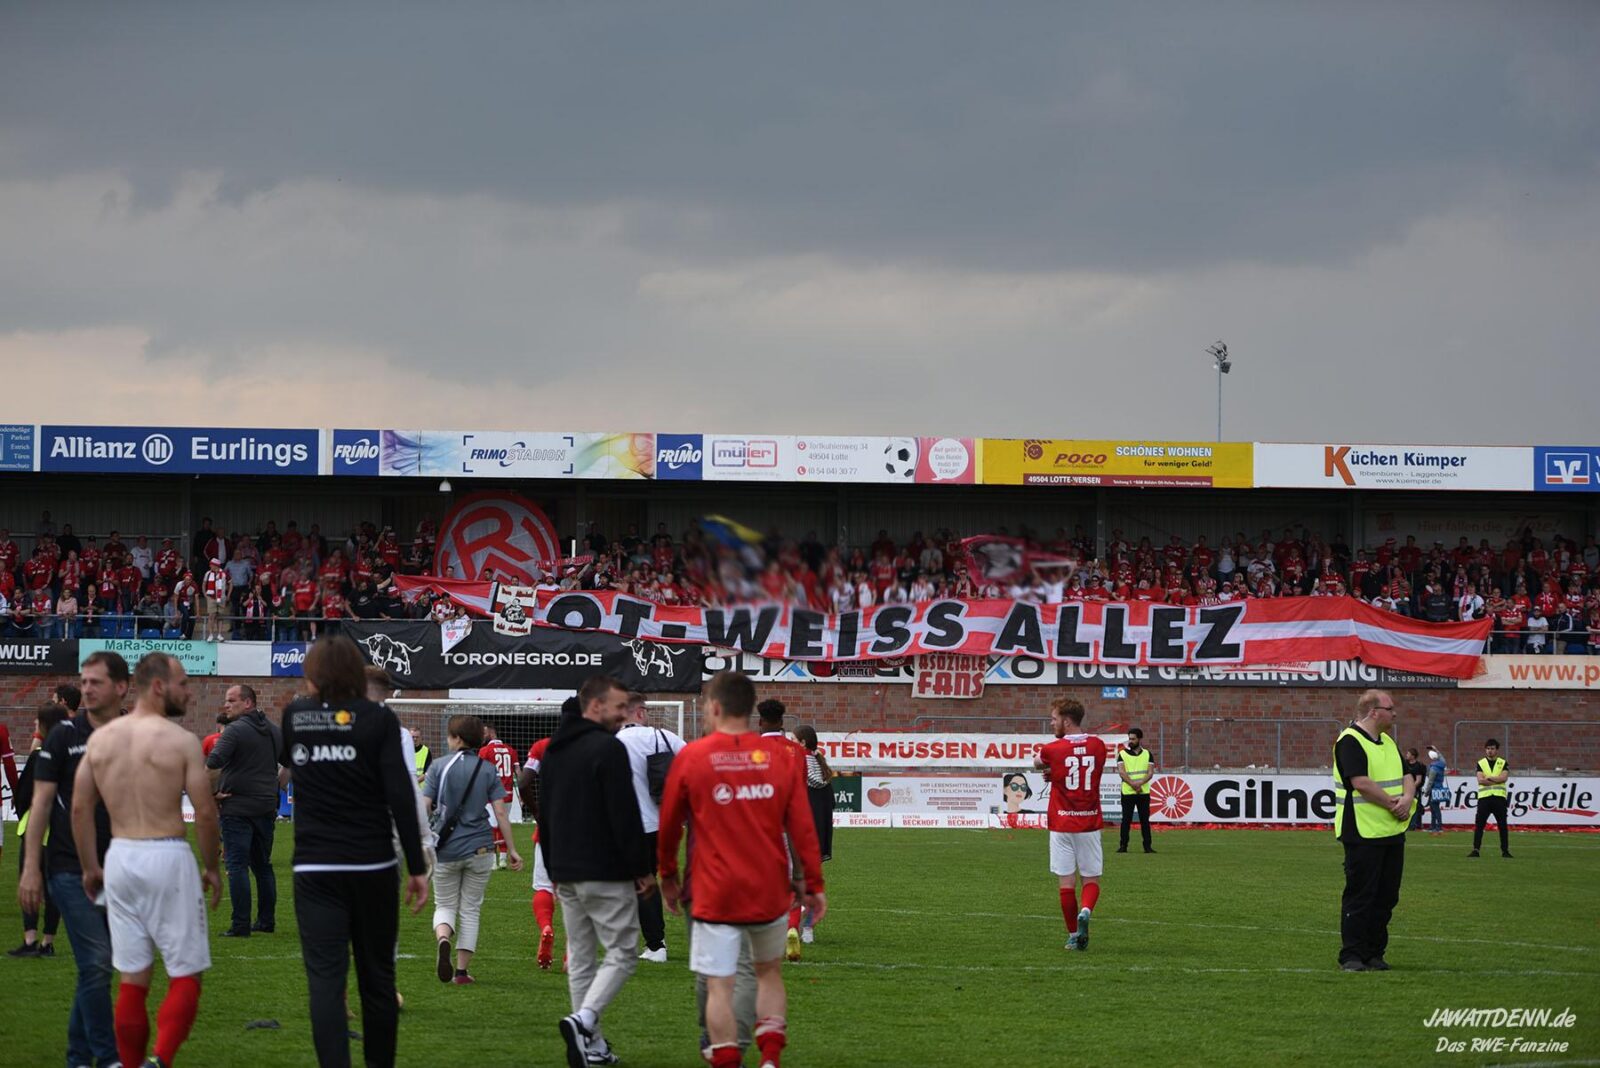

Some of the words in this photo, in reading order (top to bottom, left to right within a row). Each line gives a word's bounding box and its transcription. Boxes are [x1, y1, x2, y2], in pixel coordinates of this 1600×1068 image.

[50, 436, 136, 459] Allianz
[191, 437, 309, 467] Eurlings
[334, 444, 380, 460] FRIMO
[657, 448, 702, 464] FRIMO
[717, 446, 772, 459] müller
[809, 453, 829, 461] 49504
[1116, 444, 1165, 457] SCHÖNES
[1168, 447, 1212, 457] WOHNEN
[1054, 453, 1107, 465] POCO
[1158, 461, 1188, 469] weniger
[1325, 446, 1398, 485] Küchen
[1404, 452, 1467, 469] Kümper
[1028, 475, 1049, 483] 49504
[1050, 475, 1101, 484] LOTTE-WERSEN
[1411, 470, 1458, 478] Laggenbeck
[1418, 519, 1441, 533] Hier
[1445, 518, 1480, 533] fallen
[1482, 518, 1503, 533] die
[489, 582, 968, 657] OT-WEISS
[995, 601, 1245, 660] ALLEZ
[0, 645, 50, 660] WULFF
[105, 640, 192, 652] MaRa-Service
[441, 652, 602, 666] TORONEGRO.DE
[918, 654, 986, 672] ASOZIALE
[311, 745, 357, 762] JAKO
[878, 741, 978, 759] MÜSSEN
[495, 753, 512, 777] 20
[1065, 756, 1096, 791] 37
[834, 791, 854, 803] TÄT
[947, 819, 984, 827] BECKHOFF
